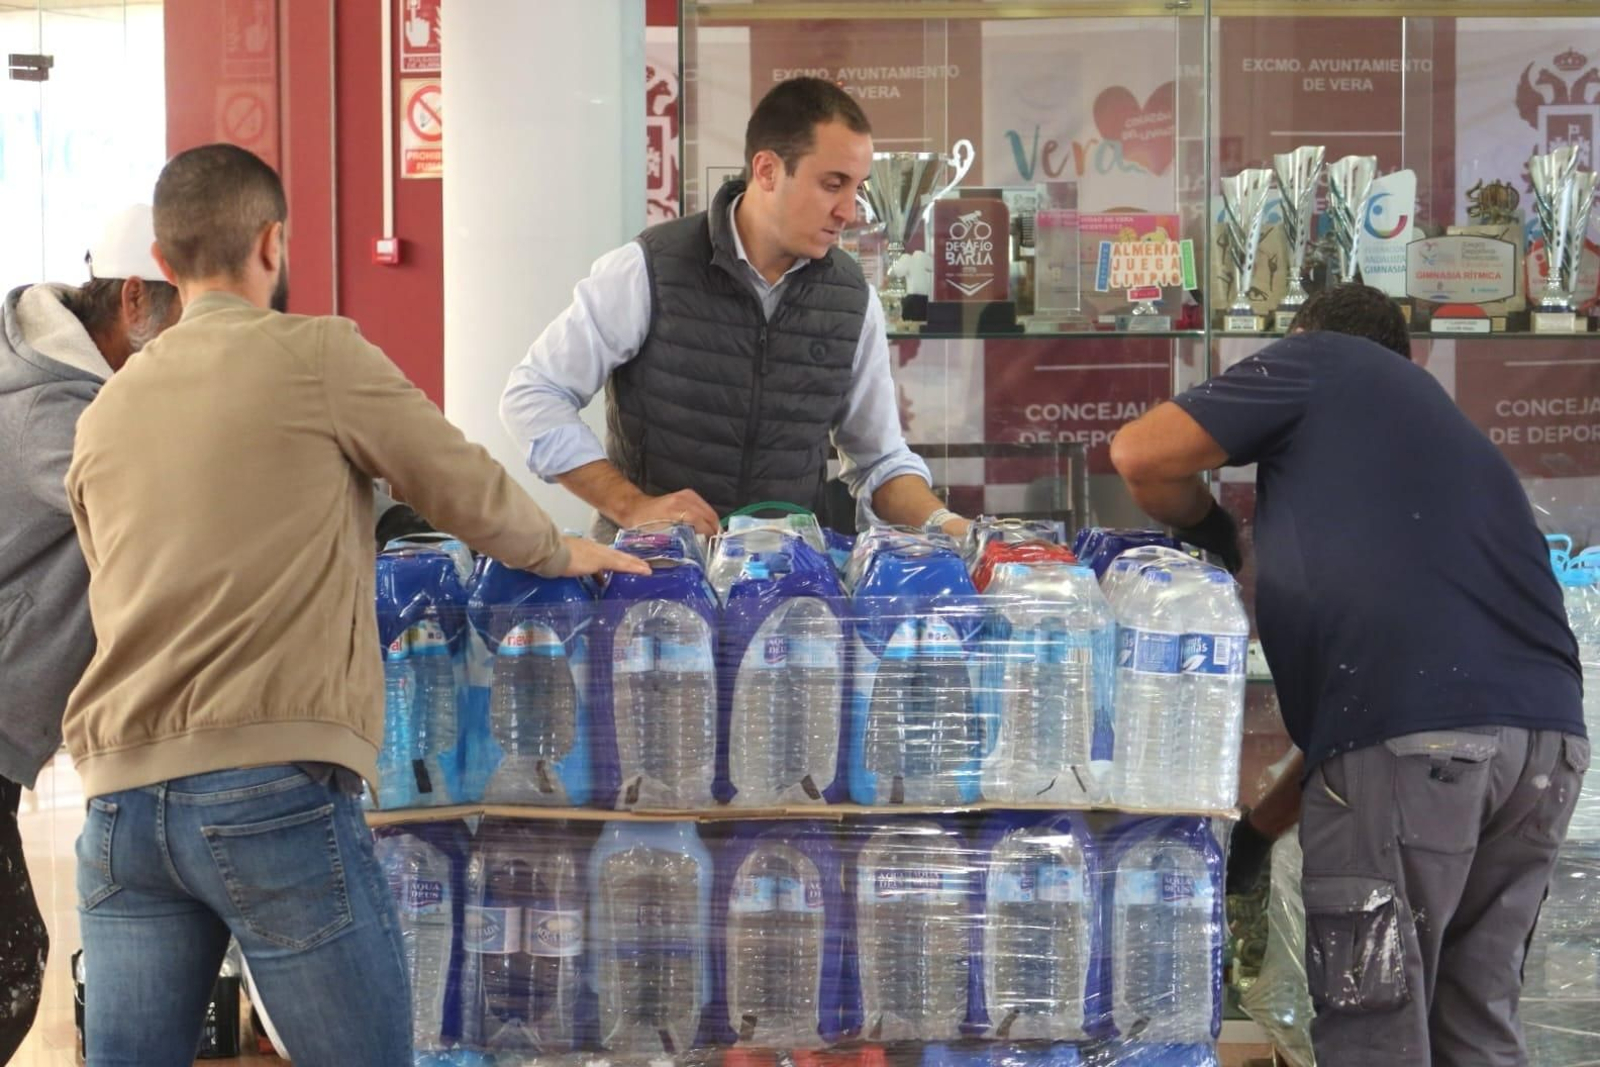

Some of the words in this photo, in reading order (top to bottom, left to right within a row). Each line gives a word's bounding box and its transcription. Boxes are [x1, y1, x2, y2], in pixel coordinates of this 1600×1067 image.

[1242, 58, 1304, 73] EXCMO.
[1308, 58, 1433, 73] AYUNTAMIENTO
[836, 64, 960, 82] AYUNTAMIENTO
[1303, 77, 1325, 91] DE
[1328, 77, 1374, 91] VERA
[857, 85, 901, 99] VERA
[1004, 123, 1148, 181] Vera
[1113, 258, 1179, 270] JUEGA
[1112, 273, 1179, 287] LIMPIO
[1489, 427, 1520, 445] DE
